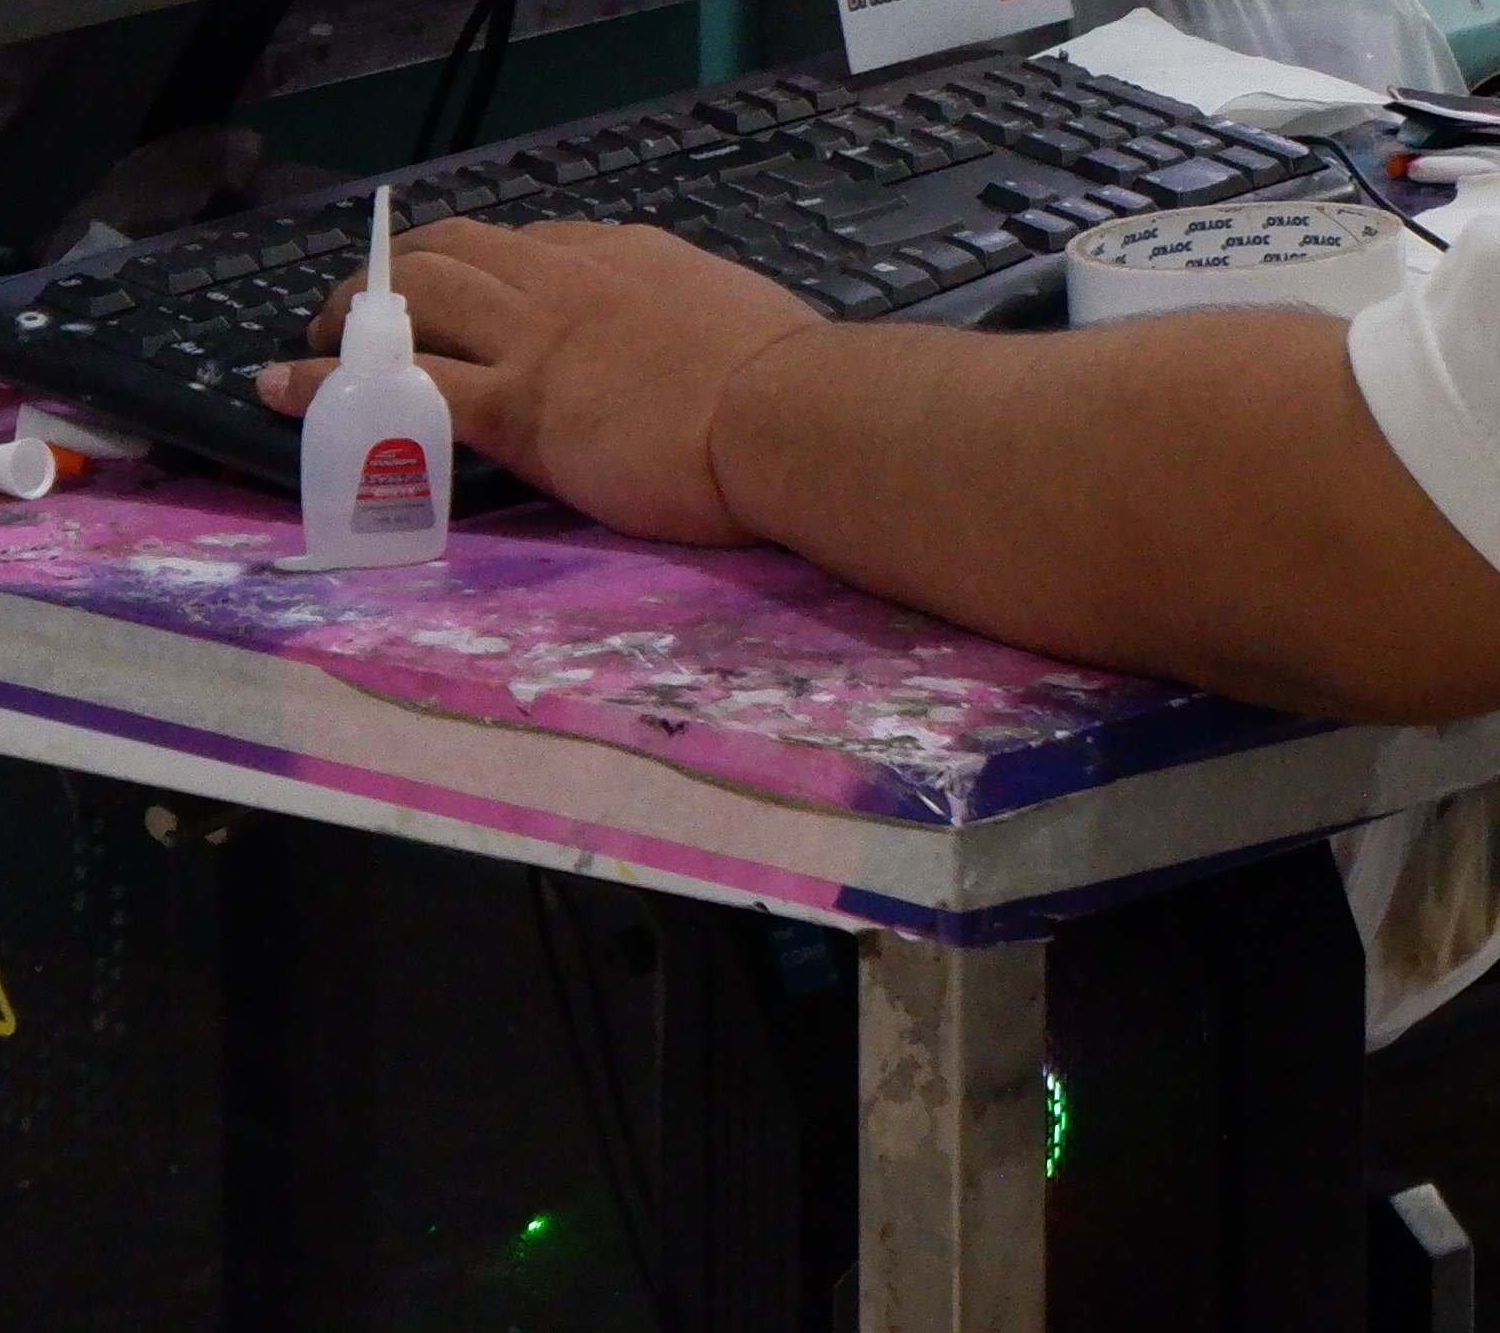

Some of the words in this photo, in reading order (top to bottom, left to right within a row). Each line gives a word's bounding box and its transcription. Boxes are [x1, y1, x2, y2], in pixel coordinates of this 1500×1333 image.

[1186, 217, 1232, 233] JOYKO
[1265, 215, 1308, 230] JOYKO
[1223, 233, 1270, 250] JOYKO
[1299, 232, 1343, 247] JOYKO
